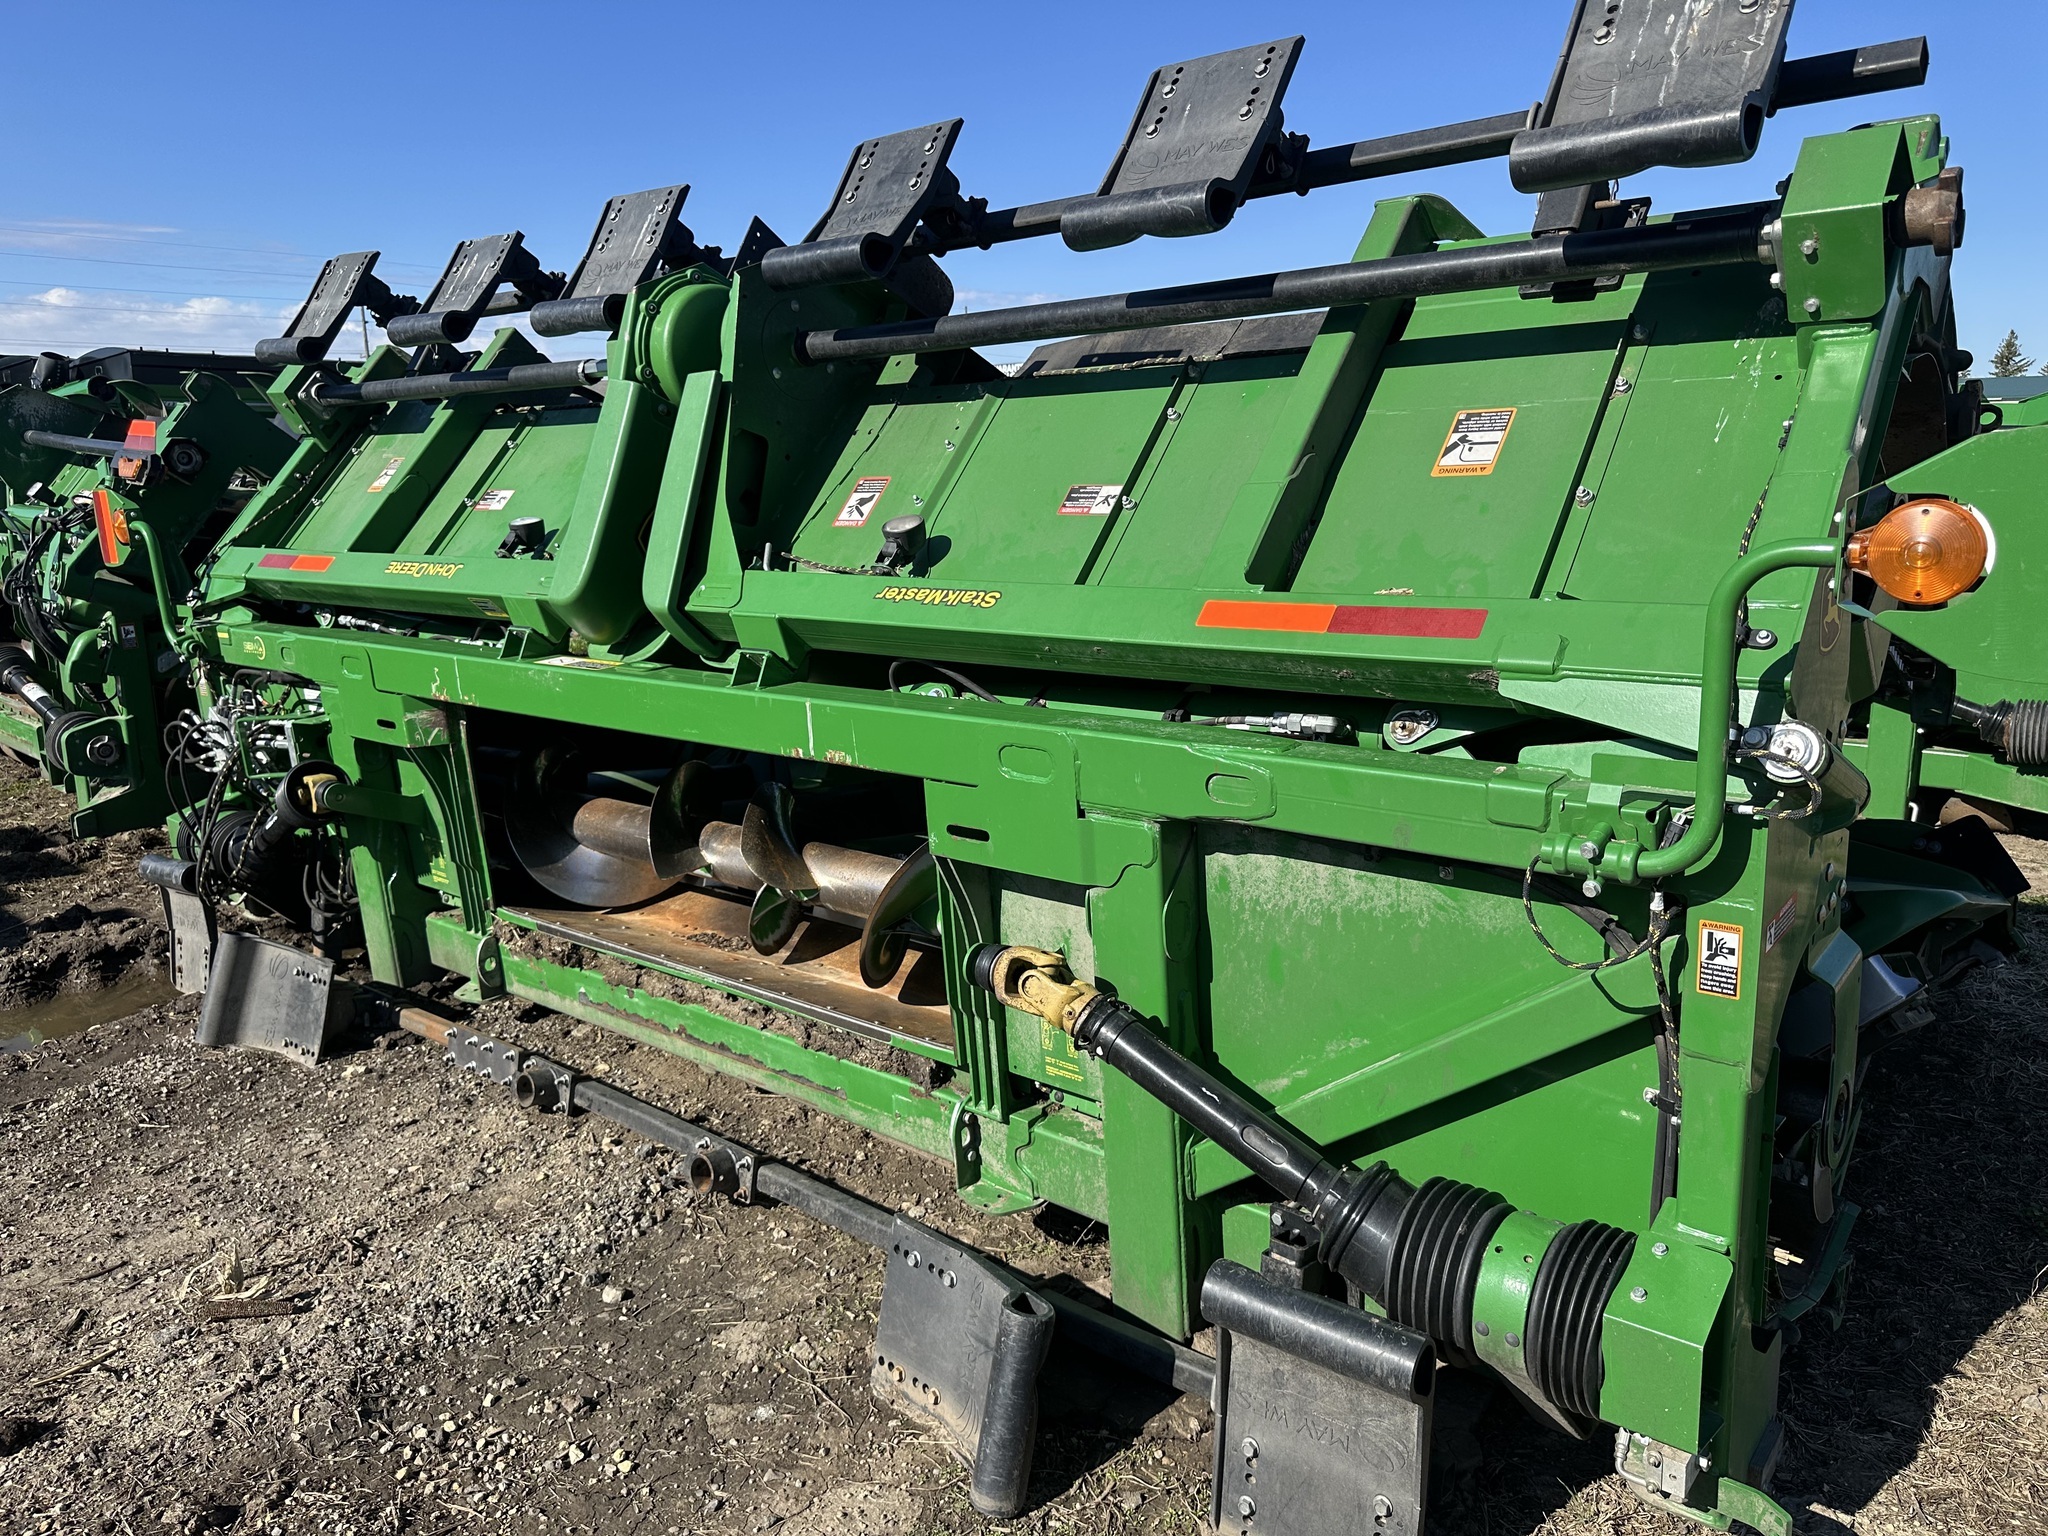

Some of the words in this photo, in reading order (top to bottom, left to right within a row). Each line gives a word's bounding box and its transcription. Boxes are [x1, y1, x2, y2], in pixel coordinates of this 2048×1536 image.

[1163, 142, 1205, 162] MAY
[874, 586, 1002, 608] StalkMaster
[1708, 922, 1740, 932] WARNING
[1296, 1418, 1350, 1453] MAY
